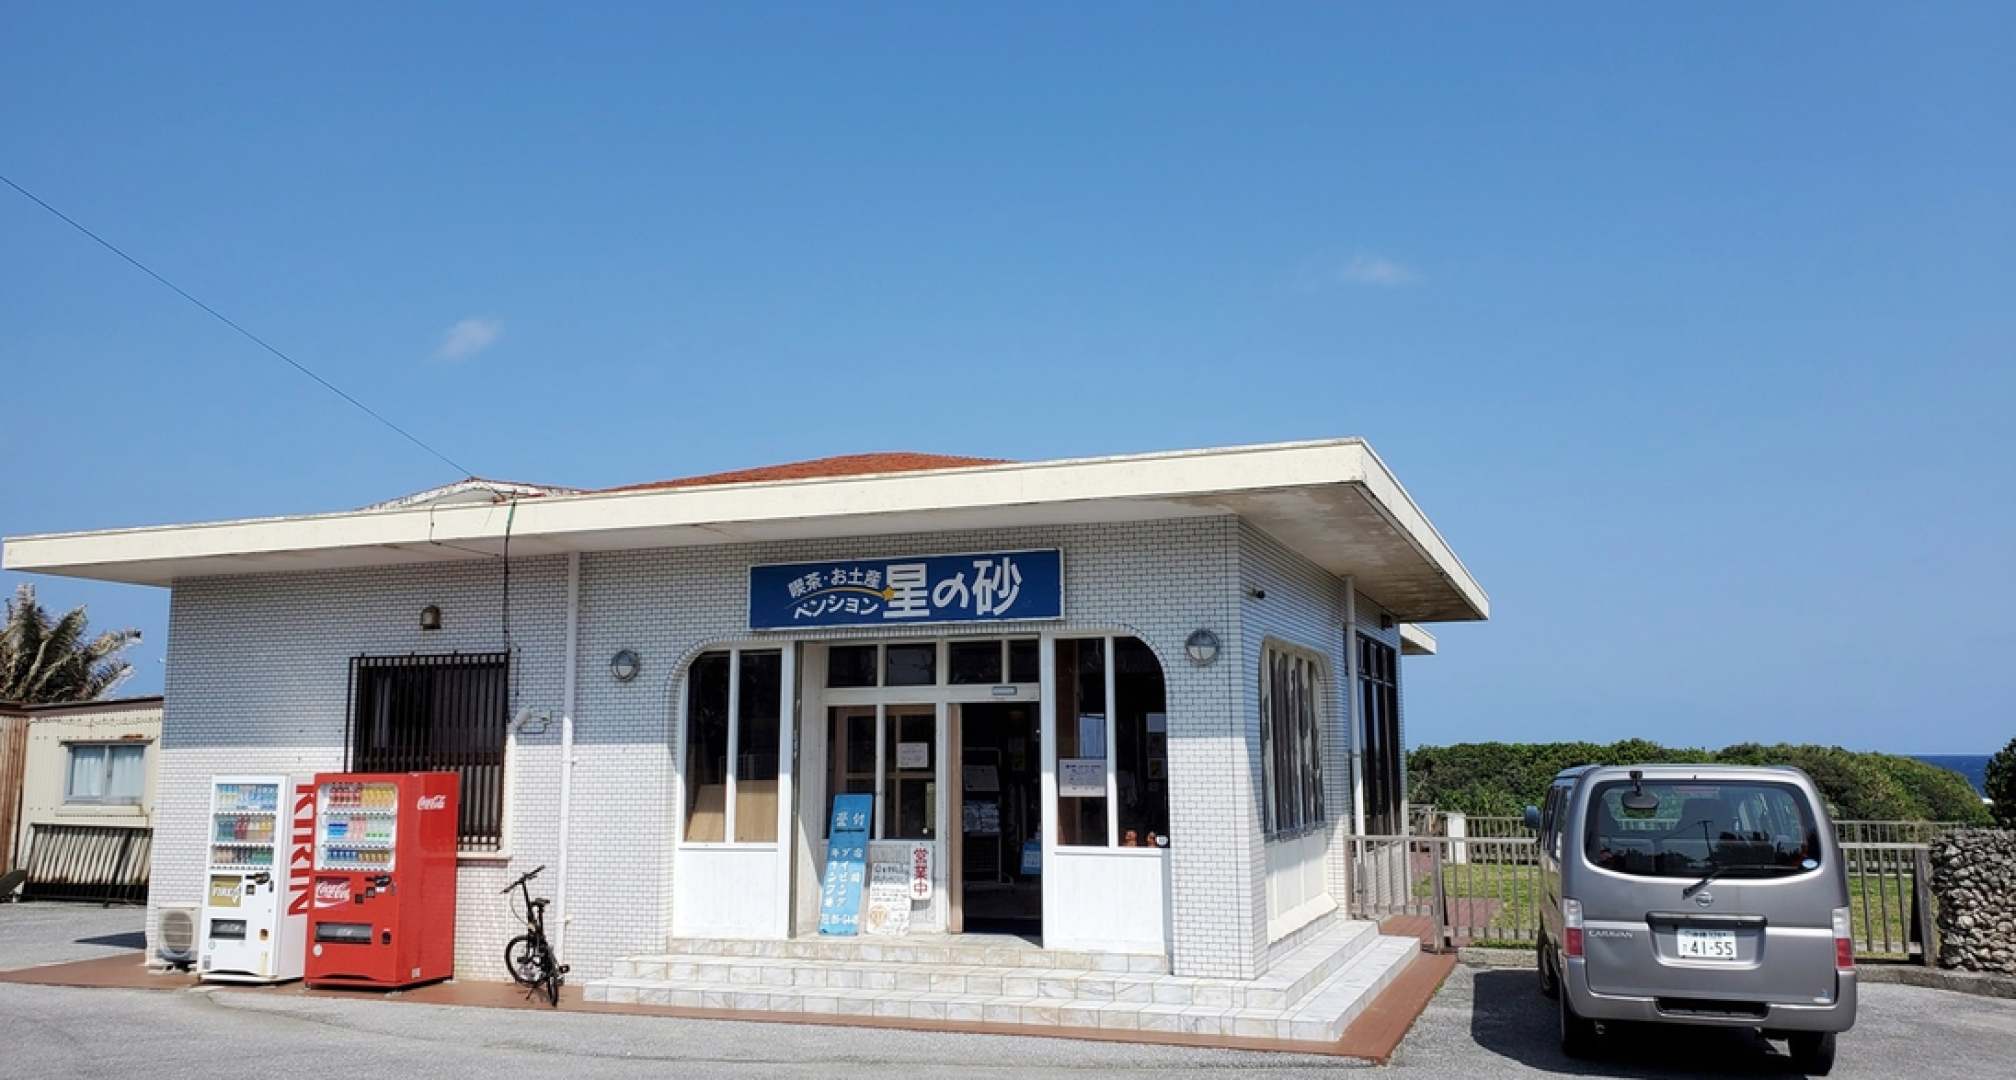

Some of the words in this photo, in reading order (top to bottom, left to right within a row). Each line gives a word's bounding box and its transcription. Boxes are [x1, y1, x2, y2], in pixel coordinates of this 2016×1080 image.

[793, 594, 880, 620] ペンション
[883, 557, 1023, 619] 星の砂
[287, 784, 314, 917] KIRIN
[914, 847, 929, 897] 営業中
